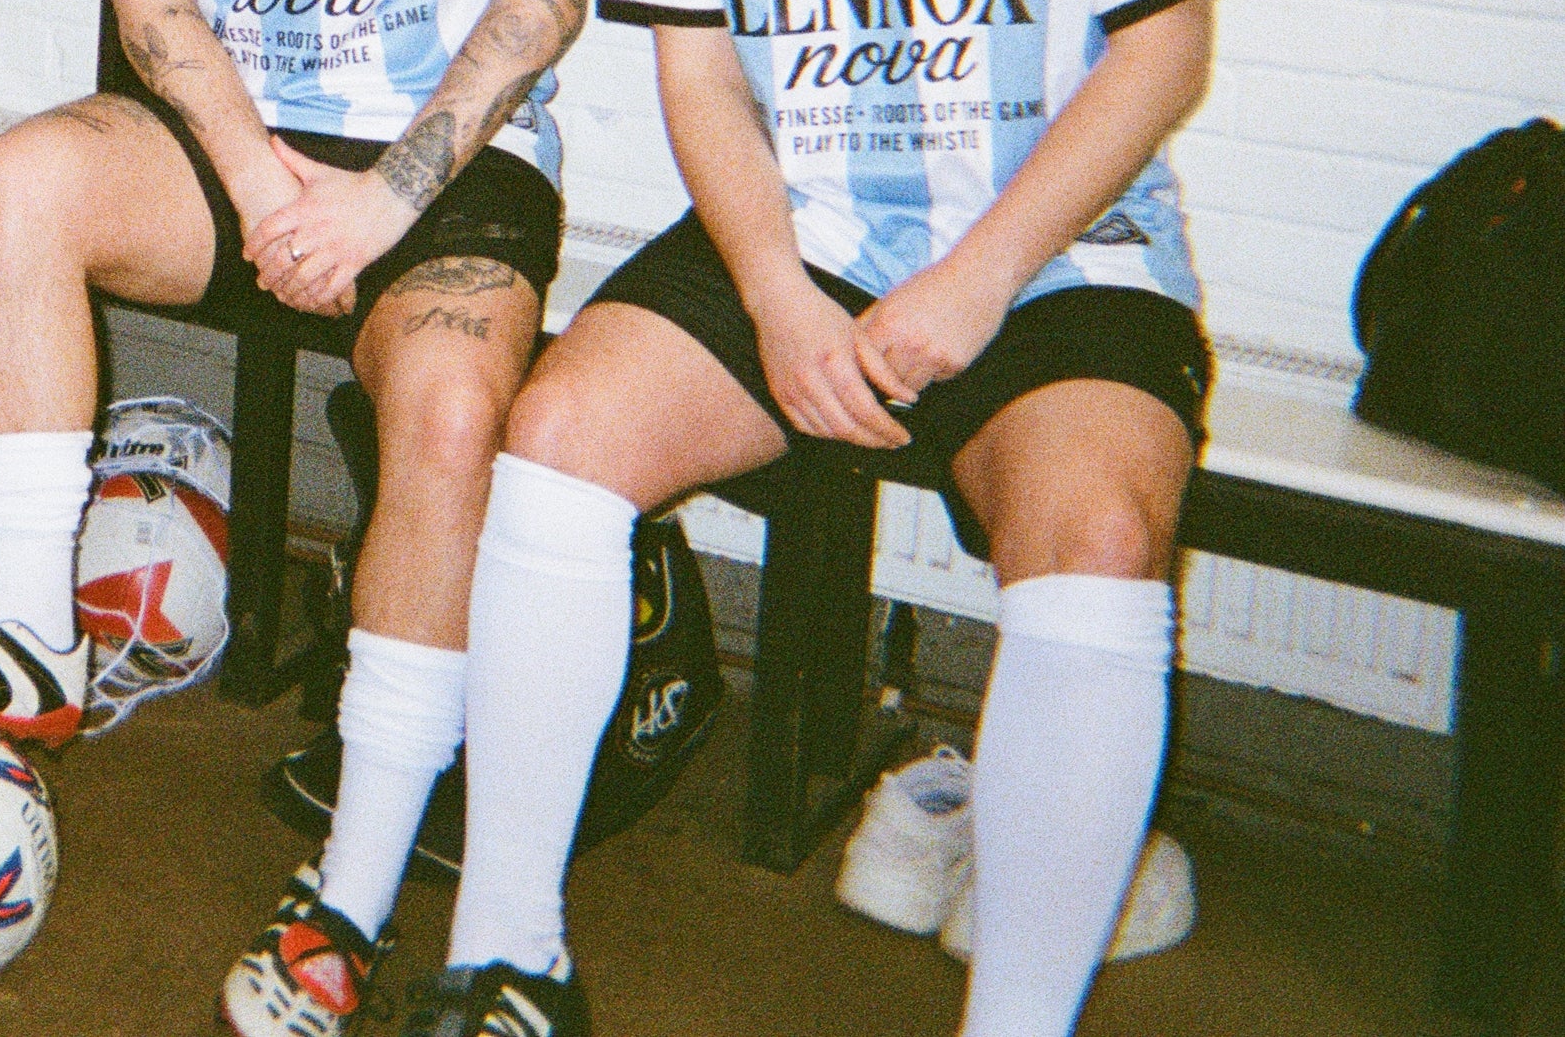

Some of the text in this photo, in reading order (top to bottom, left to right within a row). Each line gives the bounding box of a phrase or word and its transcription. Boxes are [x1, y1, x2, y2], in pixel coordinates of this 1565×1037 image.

[275, 29, 324, 51] ROOTS
[382, 4, 429, 32] GAME
[301, 45, 372, 72] WHISTLE
[784, 36, 979, 91] nova
[775, 105, 854, 129] FINESSE
[871, 103, 927, 124] ROOTS
[934, 102, 957, 122] OF
[792, 135, 832, 155] PLAY
[838, 132, 862, 152] TO
[868, 132, 903, 153] THE
